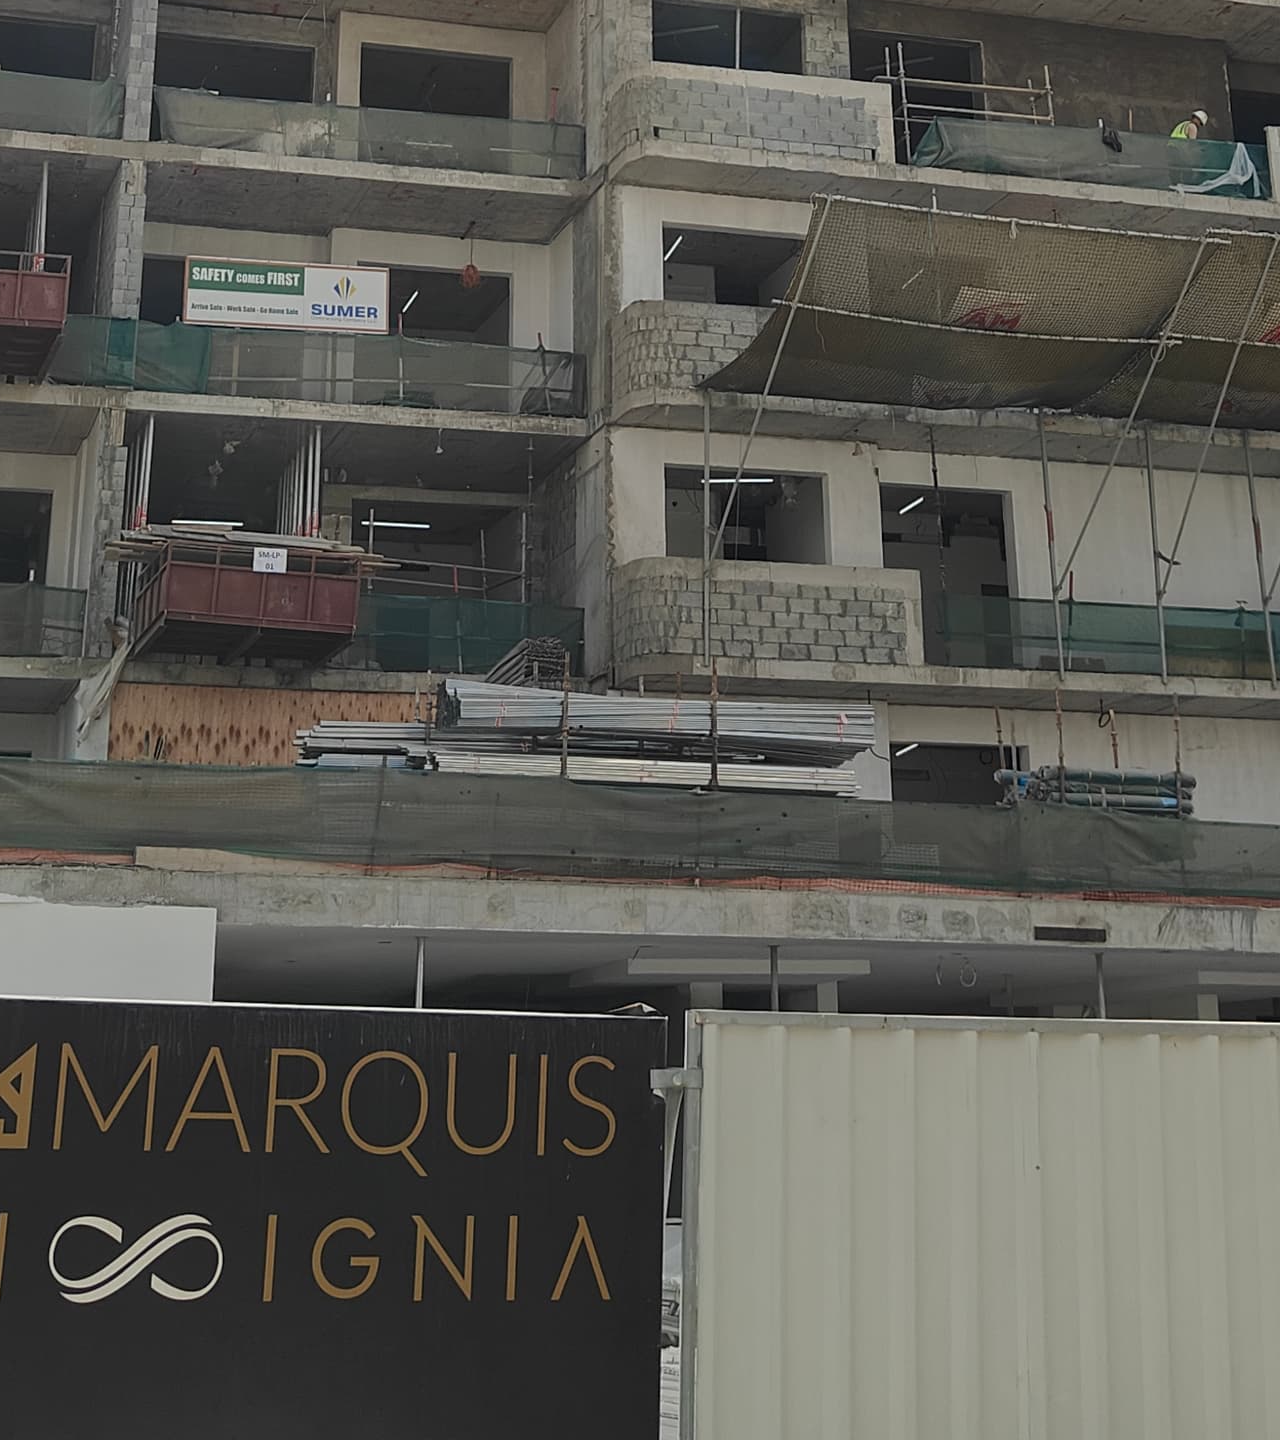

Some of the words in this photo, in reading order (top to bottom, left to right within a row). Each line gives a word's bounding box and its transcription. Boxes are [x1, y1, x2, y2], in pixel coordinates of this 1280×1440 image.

[192, 267, 234, 282] SAFETY
[236, 273, 265, 284] COMES
[267, 272, 300, 287] FIRST
[312, 304, 378, 318] SUMER
[52, 1042, 618, 1177] MARQUIS
